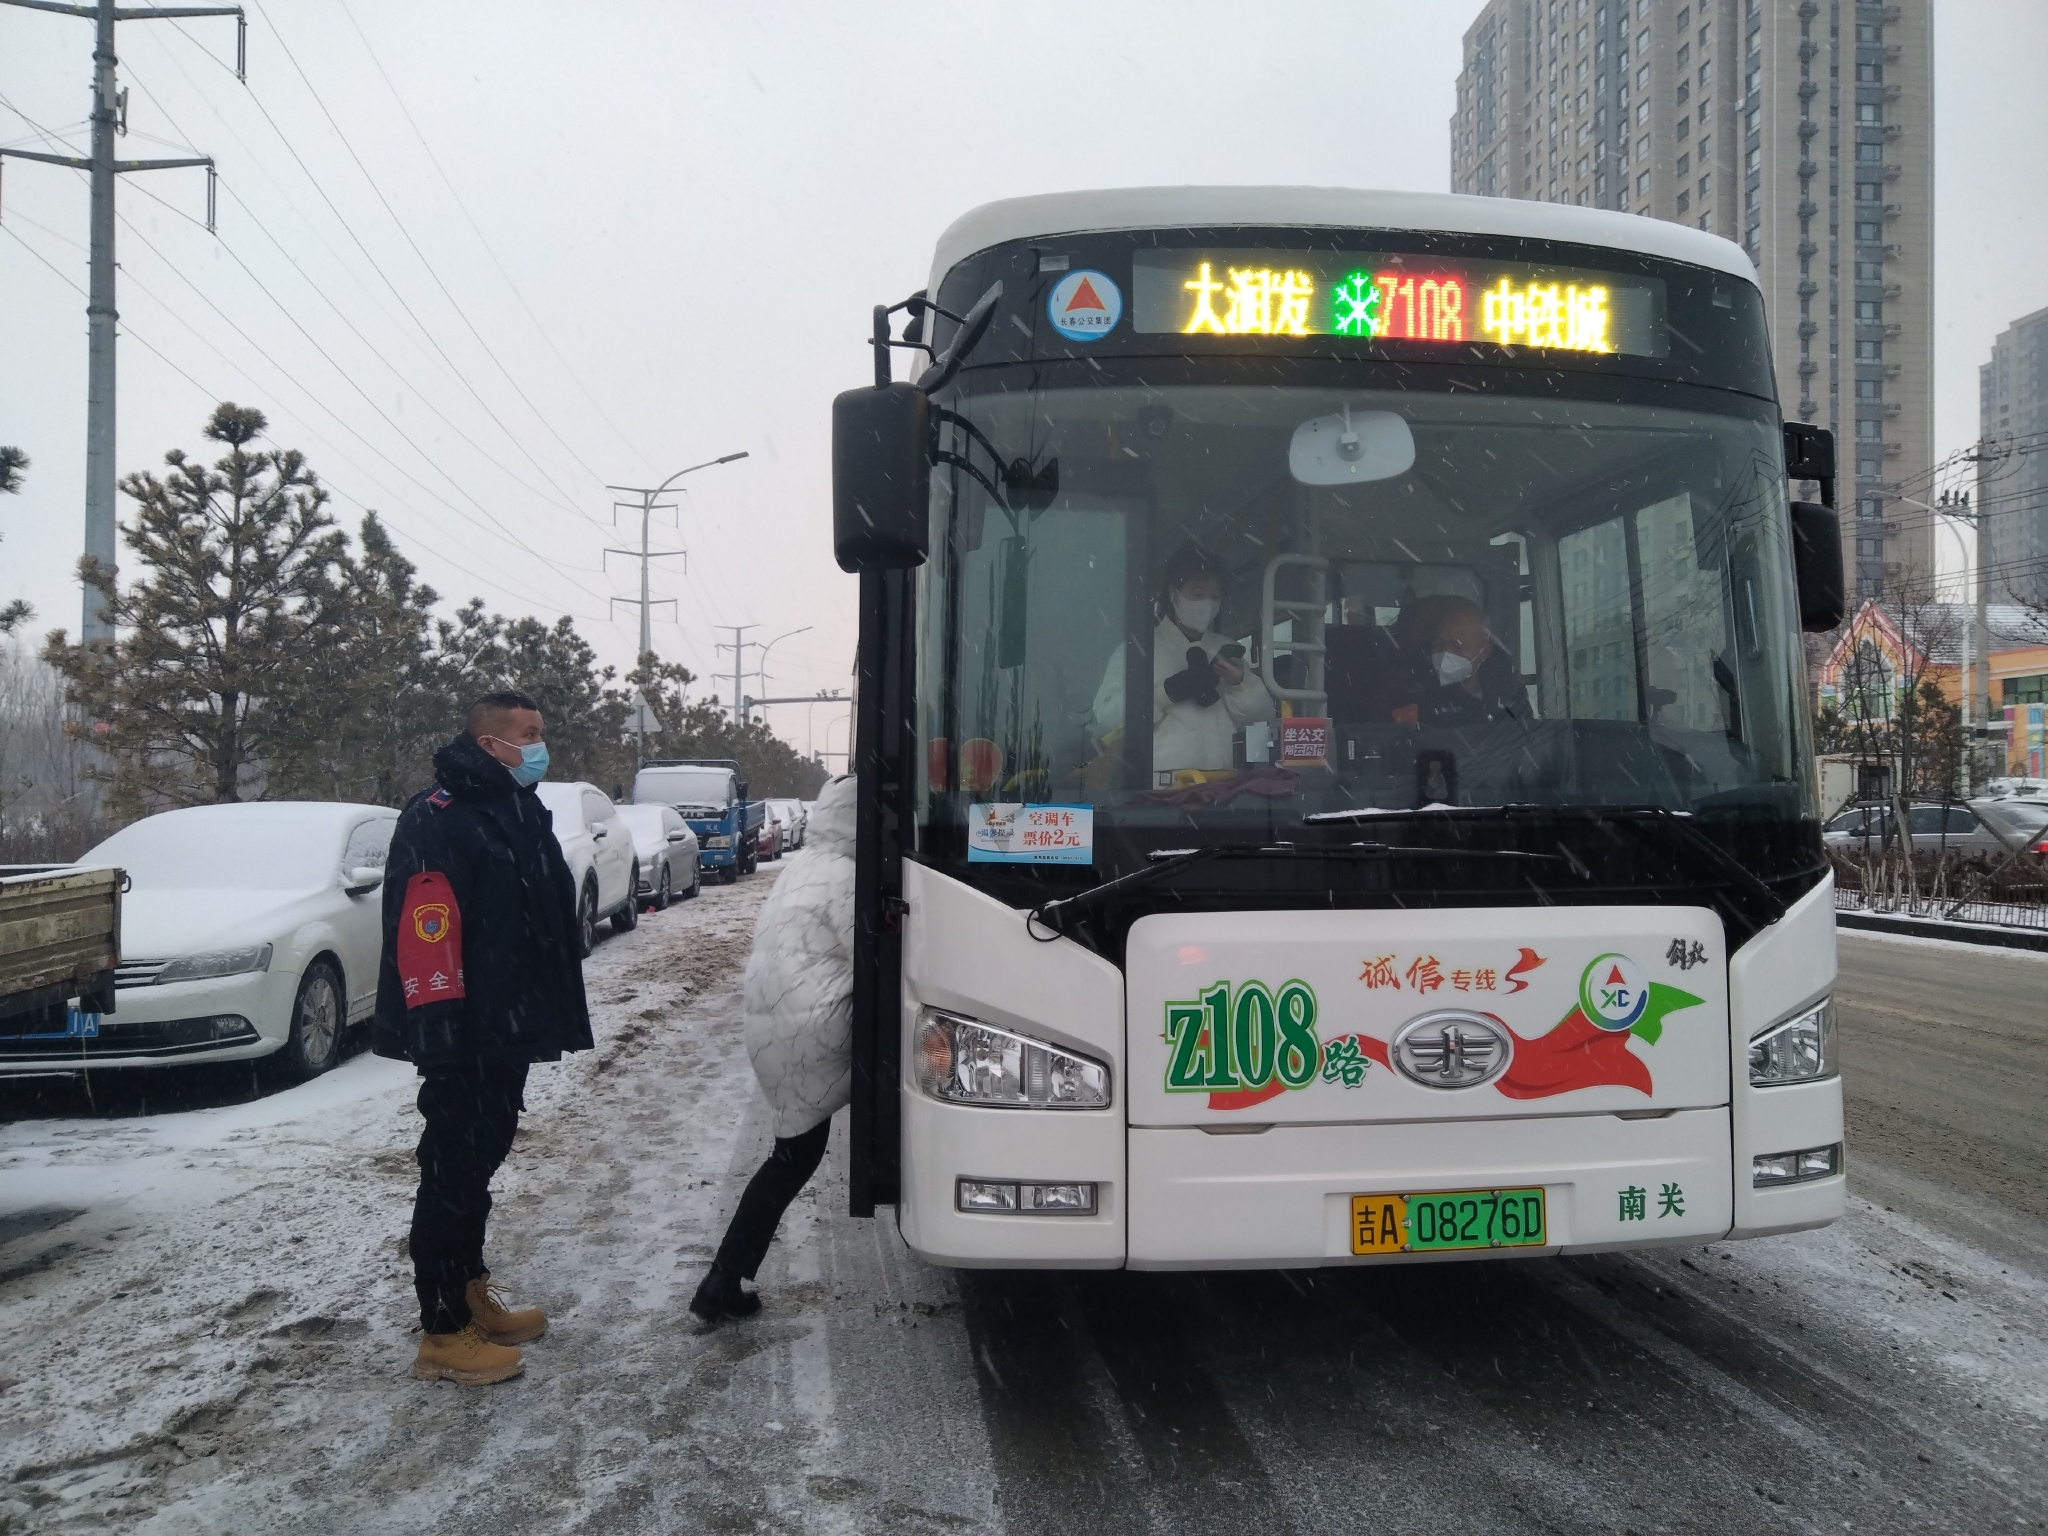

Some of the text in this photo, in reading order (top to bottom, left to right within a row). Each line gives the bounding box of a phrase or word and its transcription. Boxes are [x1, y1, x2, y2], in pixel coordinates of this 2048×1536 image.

[1184, 262, 1313, 334] 大润发
[1283, 728, 1325, 742] 坐公交
[1028, 811, 1076, 827] 空调车
[1022, 829, 1081, 847] 票价2元
[1618, 1182, 1686, 1222] 南关
